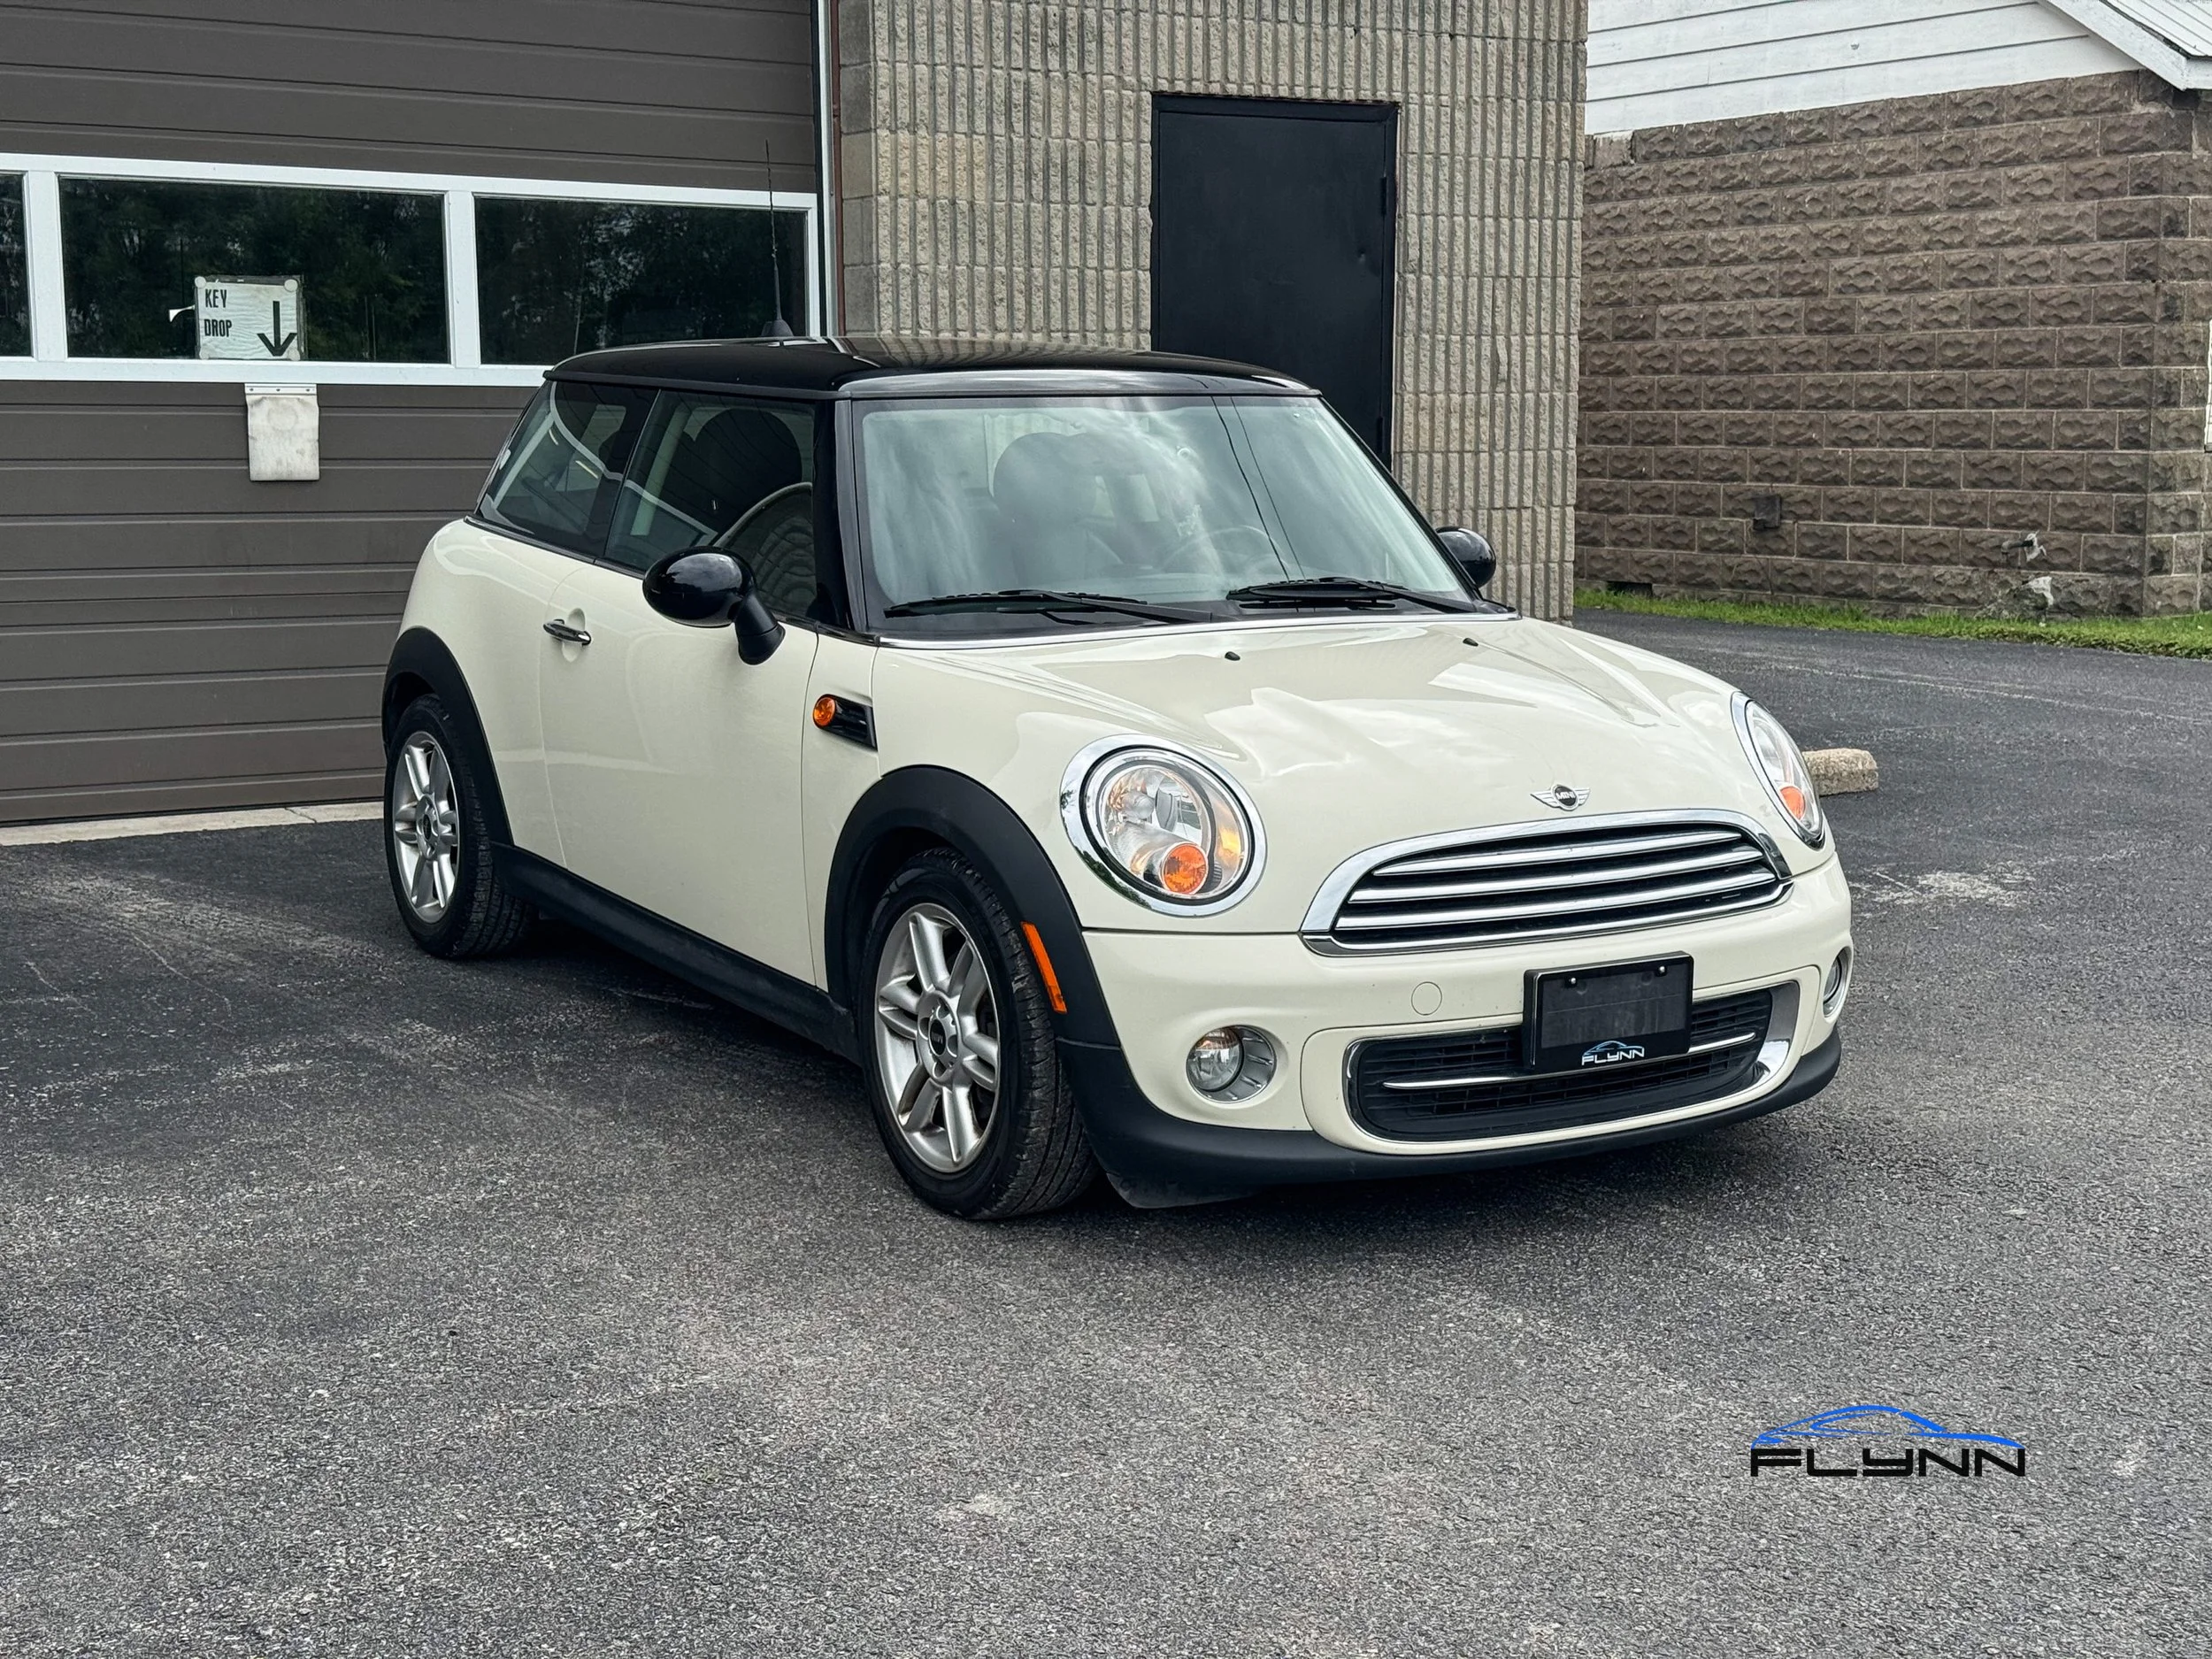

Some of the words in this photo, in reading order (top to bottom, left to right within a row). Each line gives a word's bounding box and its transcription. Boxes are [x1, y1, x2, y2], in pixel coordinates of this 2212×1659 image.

[204, 288, 227, 308] KEY
[204, 319, 233, 338] DROP
[1581, 1047, 1645, 1066] FLYNN
